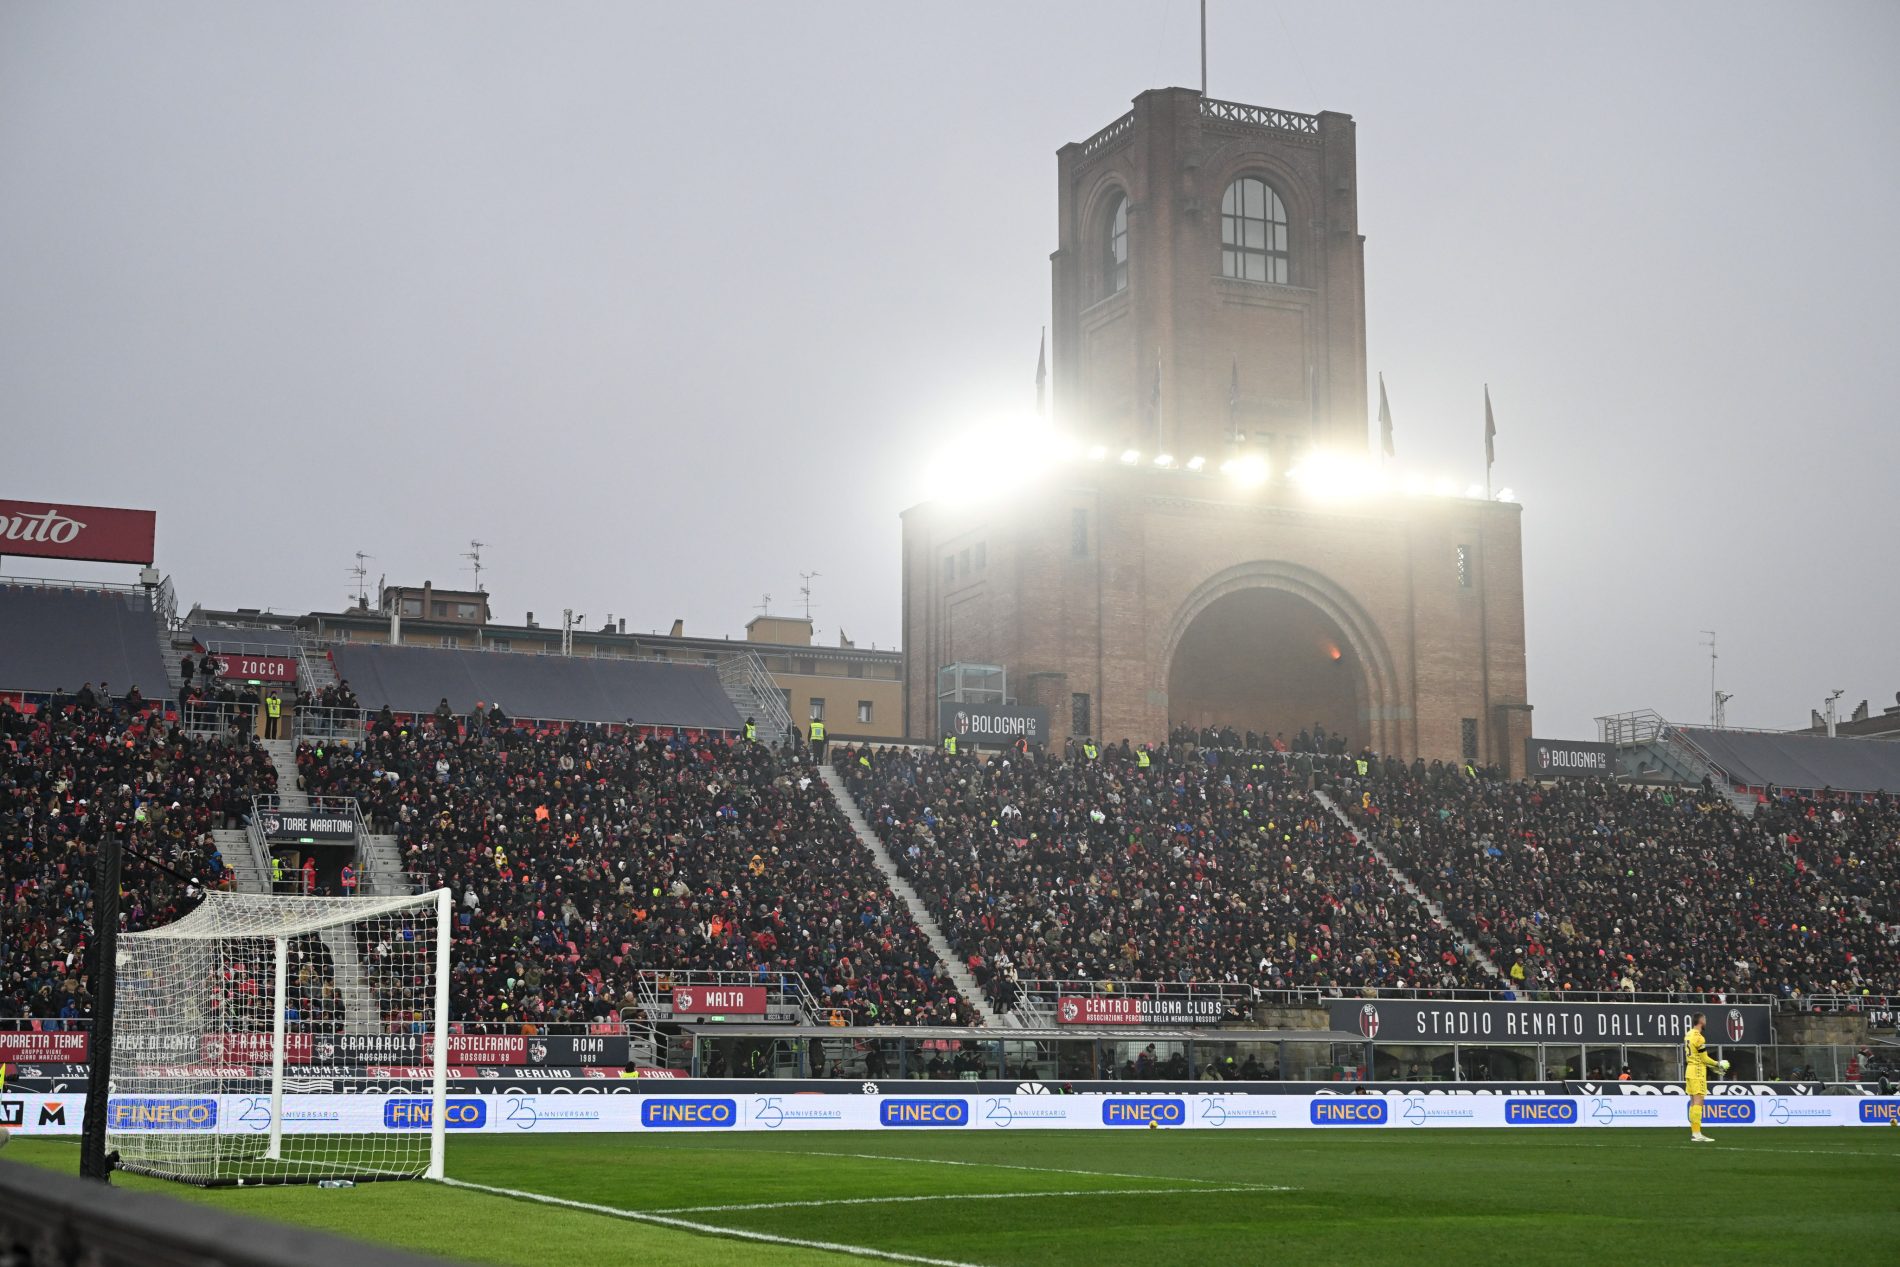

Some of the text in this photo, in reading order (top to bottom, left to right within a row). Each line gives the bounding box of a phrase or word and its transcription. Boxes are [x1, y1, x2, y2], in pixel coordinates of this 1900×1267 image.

[242, 661, 284, 676] ZOCCA
[972, 715, 1025, 735] BOLOGNA
[1552, 750, 1597, 768] BOLOGNA
[283, 818, 353, 833] TORRE MARATONA
[706, 991, 744, 1007] MALTA
[1086, 1000, 1222, 1015] CENTRO BOLOGNA CLUBS
[1086, 1014, 1123, 1022] ASSOCIAZIONE
[1125, 1014, 1152, 1023] PERCORSO
[1153, 1015, 1169, 1023] DELLA
[1170, 1015, 1194, 1023] MEMORIA
[1417, 1011, 1693, 1036] STADIO RENATO DALL'ARA
[0, 1034, 84, 1048] PORRETTA TERME
[115, 1035, 145, 1049] PIEVE
[163, 1035, 197, 1049] CENTO
[340, 1036, 416, 1050] GRANAROLO
[447, 1036, 524, 1051] CASTELFRANCO
[573, 1038, 604, 1052] ROMA
[359, 1052, 397, 1061] ROSSOBLU
[460, 1053, 495, 1062] ROSSOBLU
[580, 1054, 597, 1062] 1989
[290, 1066, 350, 1074] PHUKET
[406, 1068, 462, 1078] MADID
[514, 1069, 572, 1078] BERLINO
[116, 1105, 209, 1123] FINECO
[393, 1105, 479, 1122] FINCO
[649, 1105, 729, 1121] FINECO
[887, 1105, 962, 1121] FINECO
[1109, 1104, 1179, 1121] FINECO
[1316, 1104, 1383, 1120] FINECO
[1511, 1104, 1573, 1119] FINECO
[1700, 1104, 1751, 1118] INECO
